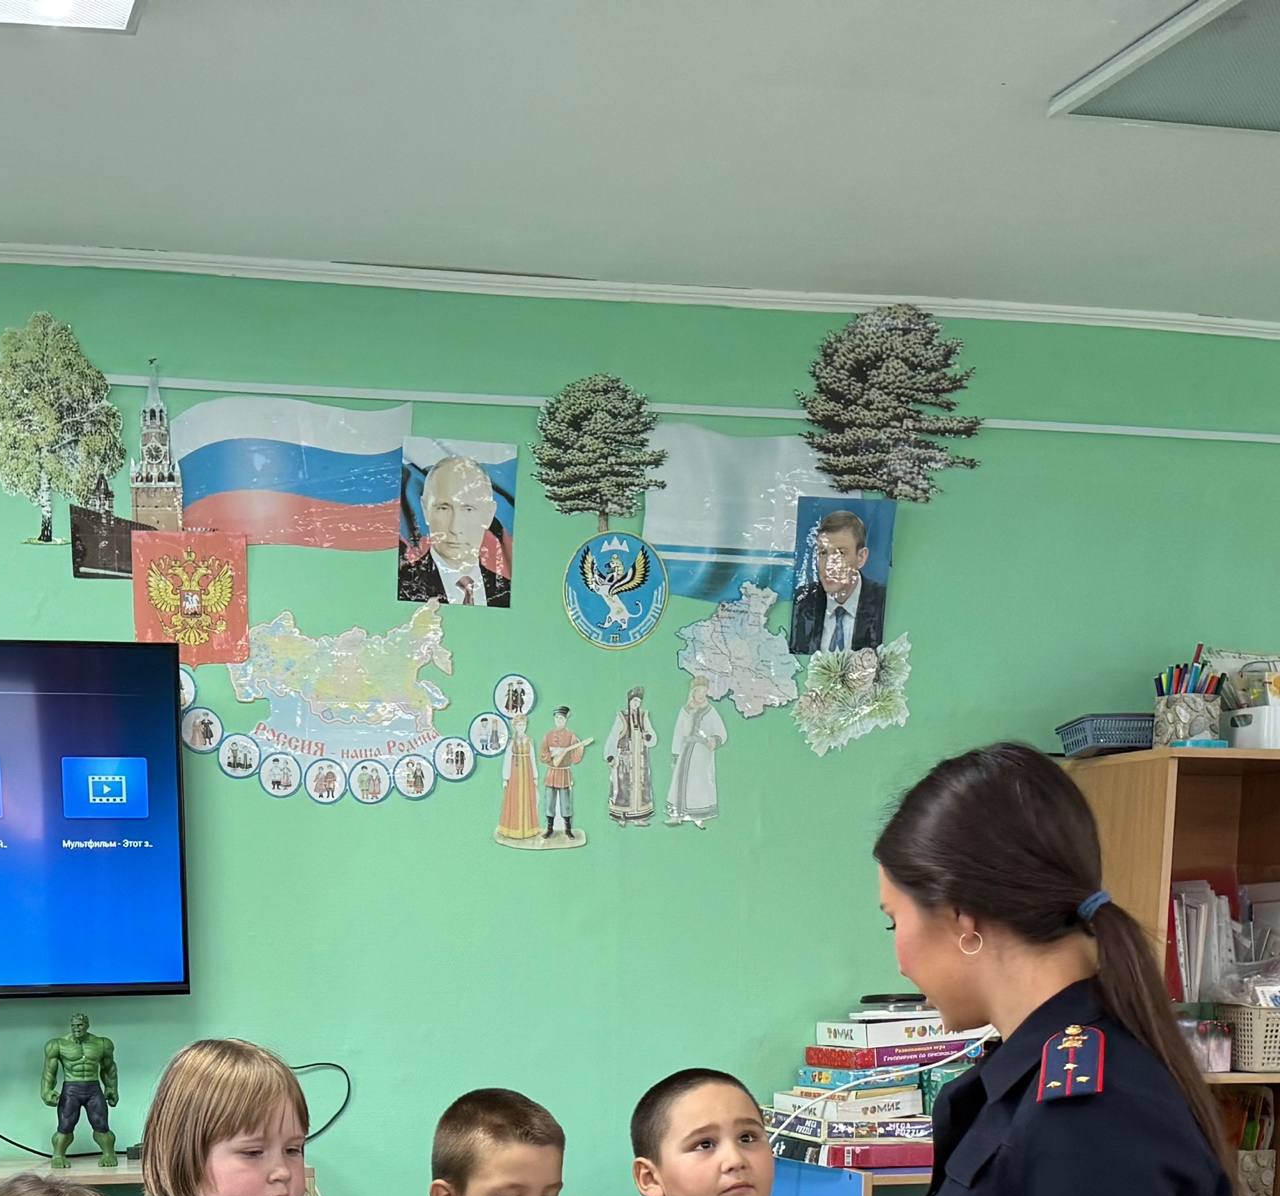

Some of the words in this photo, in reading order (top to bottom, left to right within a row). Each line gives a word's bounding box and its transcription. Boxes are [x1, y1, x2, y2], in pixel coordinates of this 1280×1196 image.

[254, 722, 326, 757] РОССИЯ
[340, 748, 383, 760] наша
[386, 729, 440, 754] Родина
[62, 838, 117, 850] Мультфильм
[122, 839, 143, 849] Этот
[861, 1101, 901, 1116] ТОМИК
